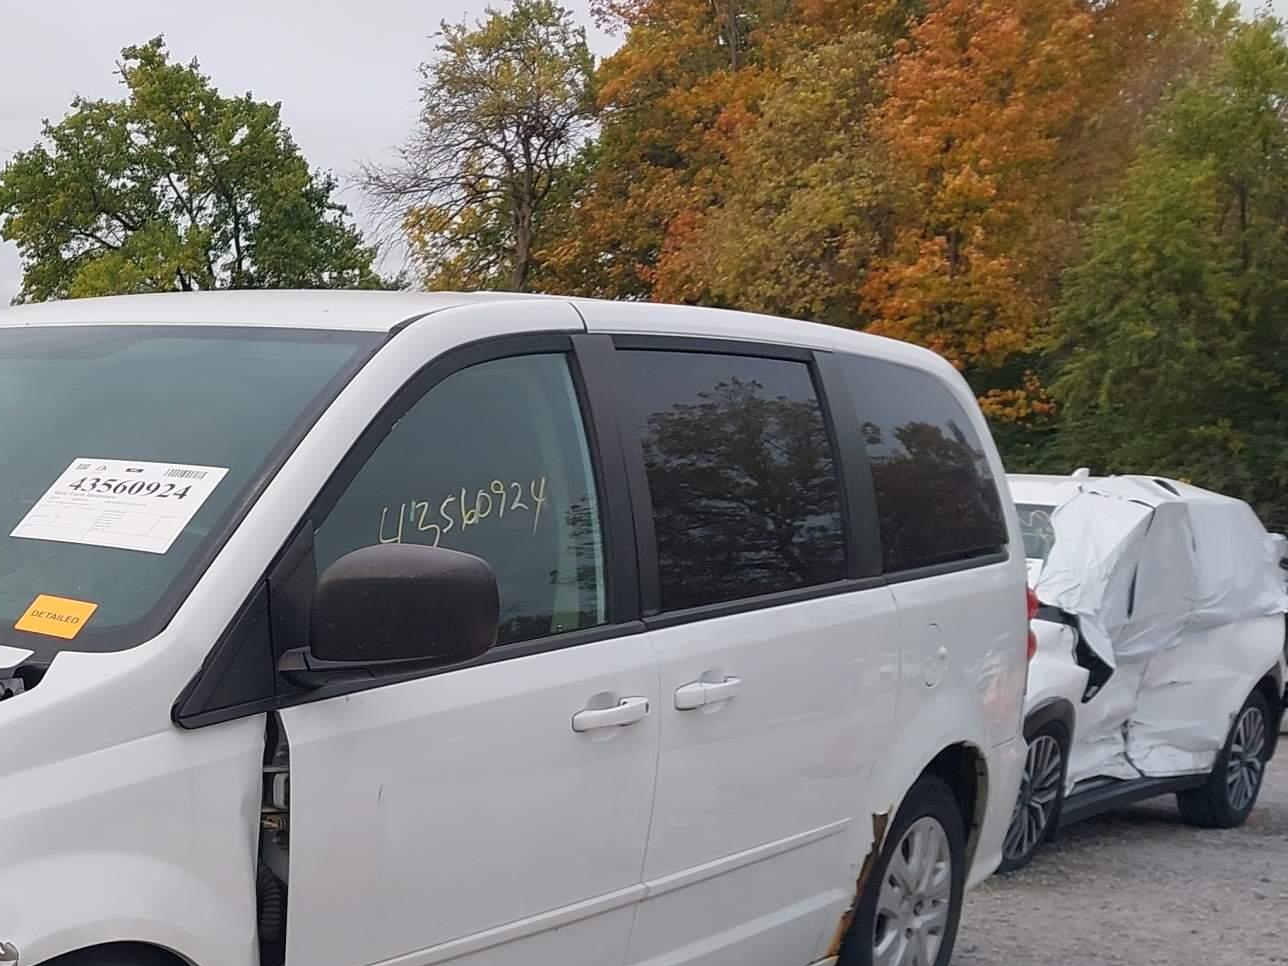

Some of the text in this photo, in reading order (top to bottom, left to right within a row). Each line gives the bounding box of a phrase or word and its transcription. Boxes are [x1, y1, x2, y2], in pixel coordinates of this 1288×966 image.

[69, 476, 192, 500] 43560924
[379, 477, 547, 547] 43560924
[31, 609, 80, 624] DETAILED
